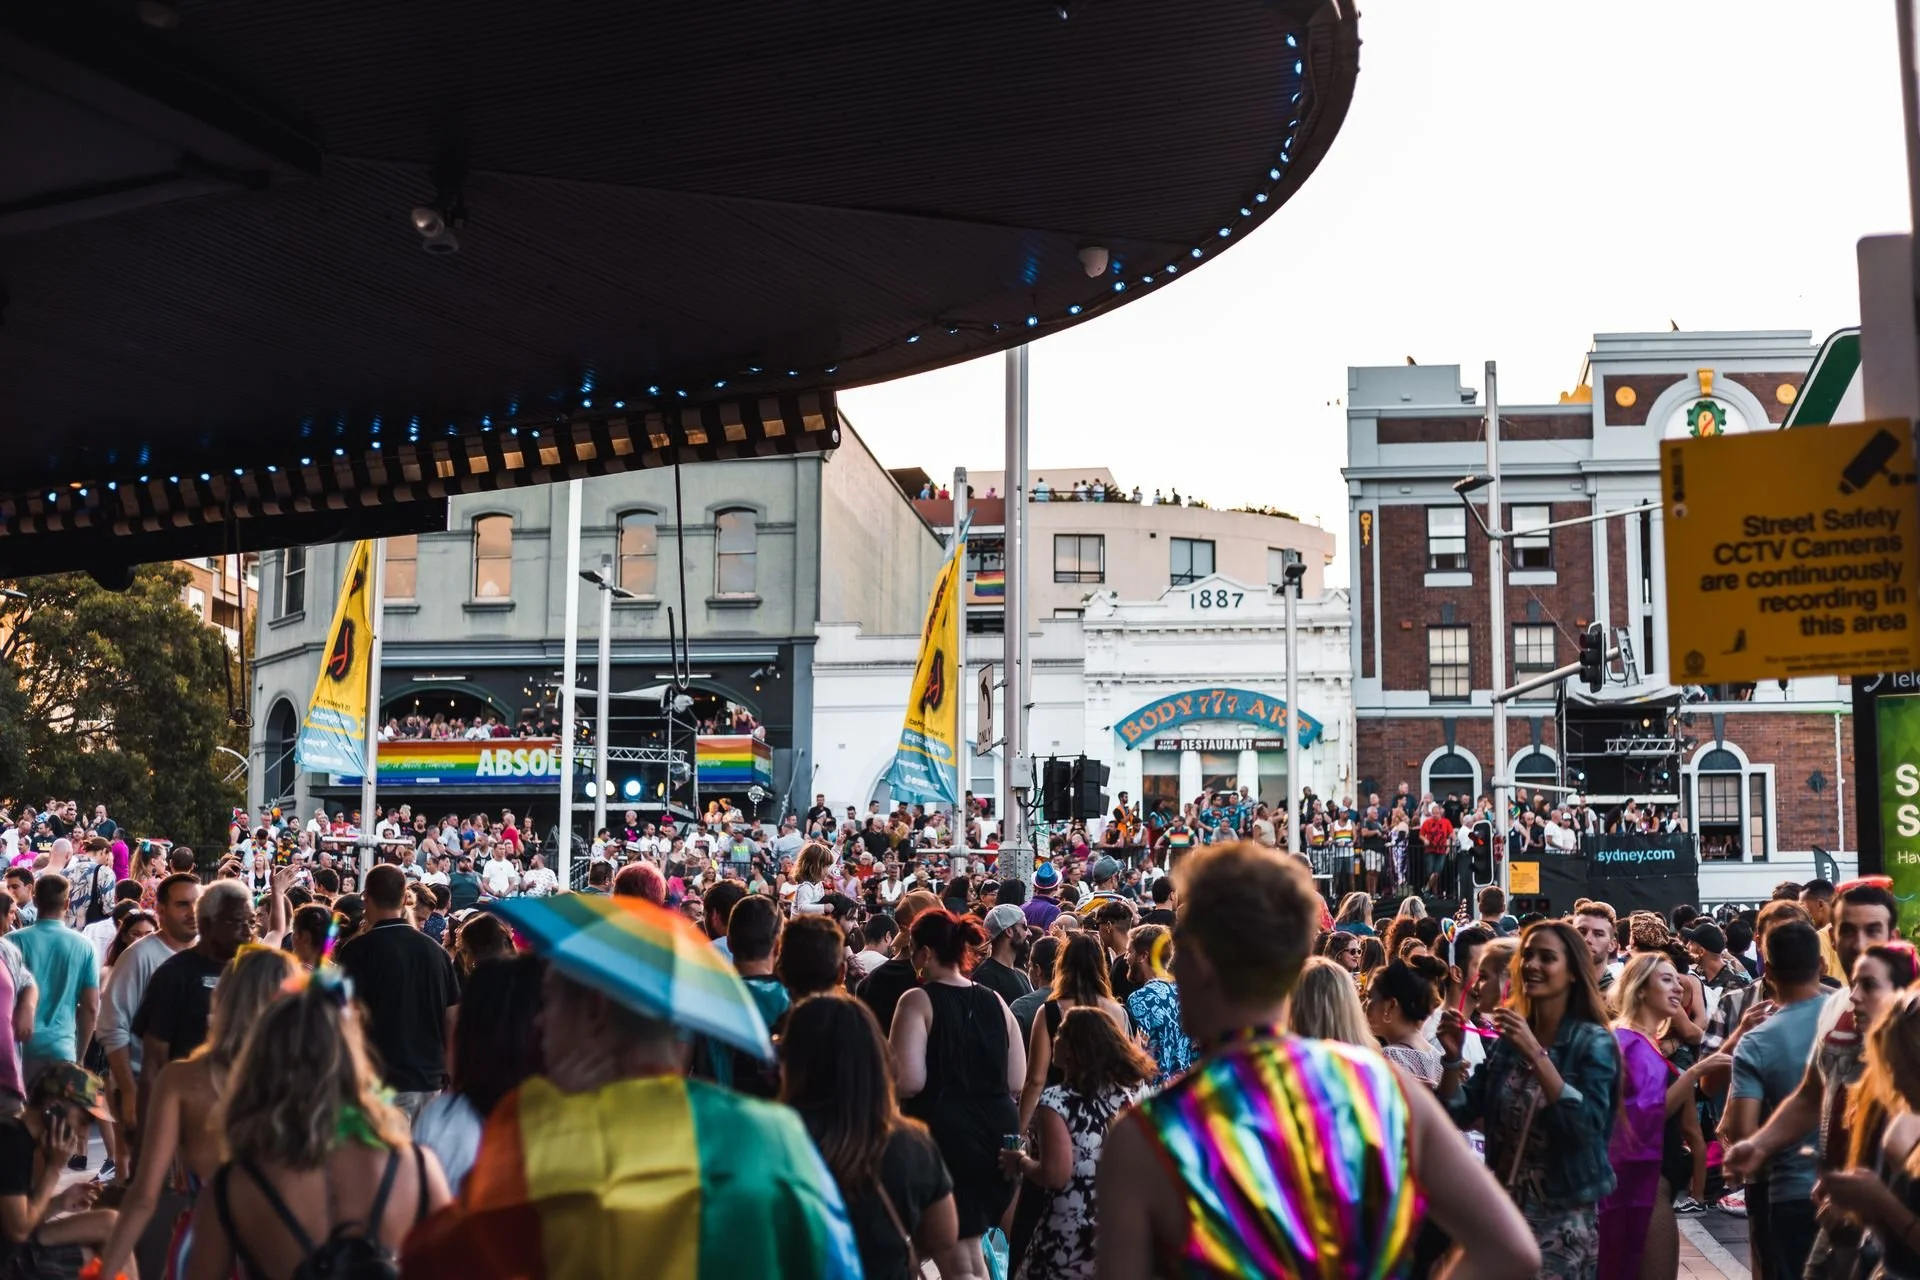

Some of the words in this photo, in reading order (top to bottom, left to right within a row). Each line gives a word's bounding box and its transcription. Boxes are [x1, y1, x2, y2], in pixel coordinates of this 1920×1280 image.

[1743, 512, 1815, 537] Street
[1824, 506, 1899, 531] Safety
[1714, 539, 1786, 565] CCTV
[1792, 535, 1903, 558] Cameras
[1701, 574, 1739, 592] are
[1746, 558, 1903, 588] continuously
[1190, 589, 1244, 609] 1887
[1759, 586, 1877, 613] recording
[1885, 584, 1906, 604] in
[1801, 613, 1845, 637] this
[1853, 614, 1907, 634] area
[1122, 696, 1192, 742] BODY
[1181, 739, 1252, 750] RESTAURANT
[1597, 849, 1675, 864] sydney.com
